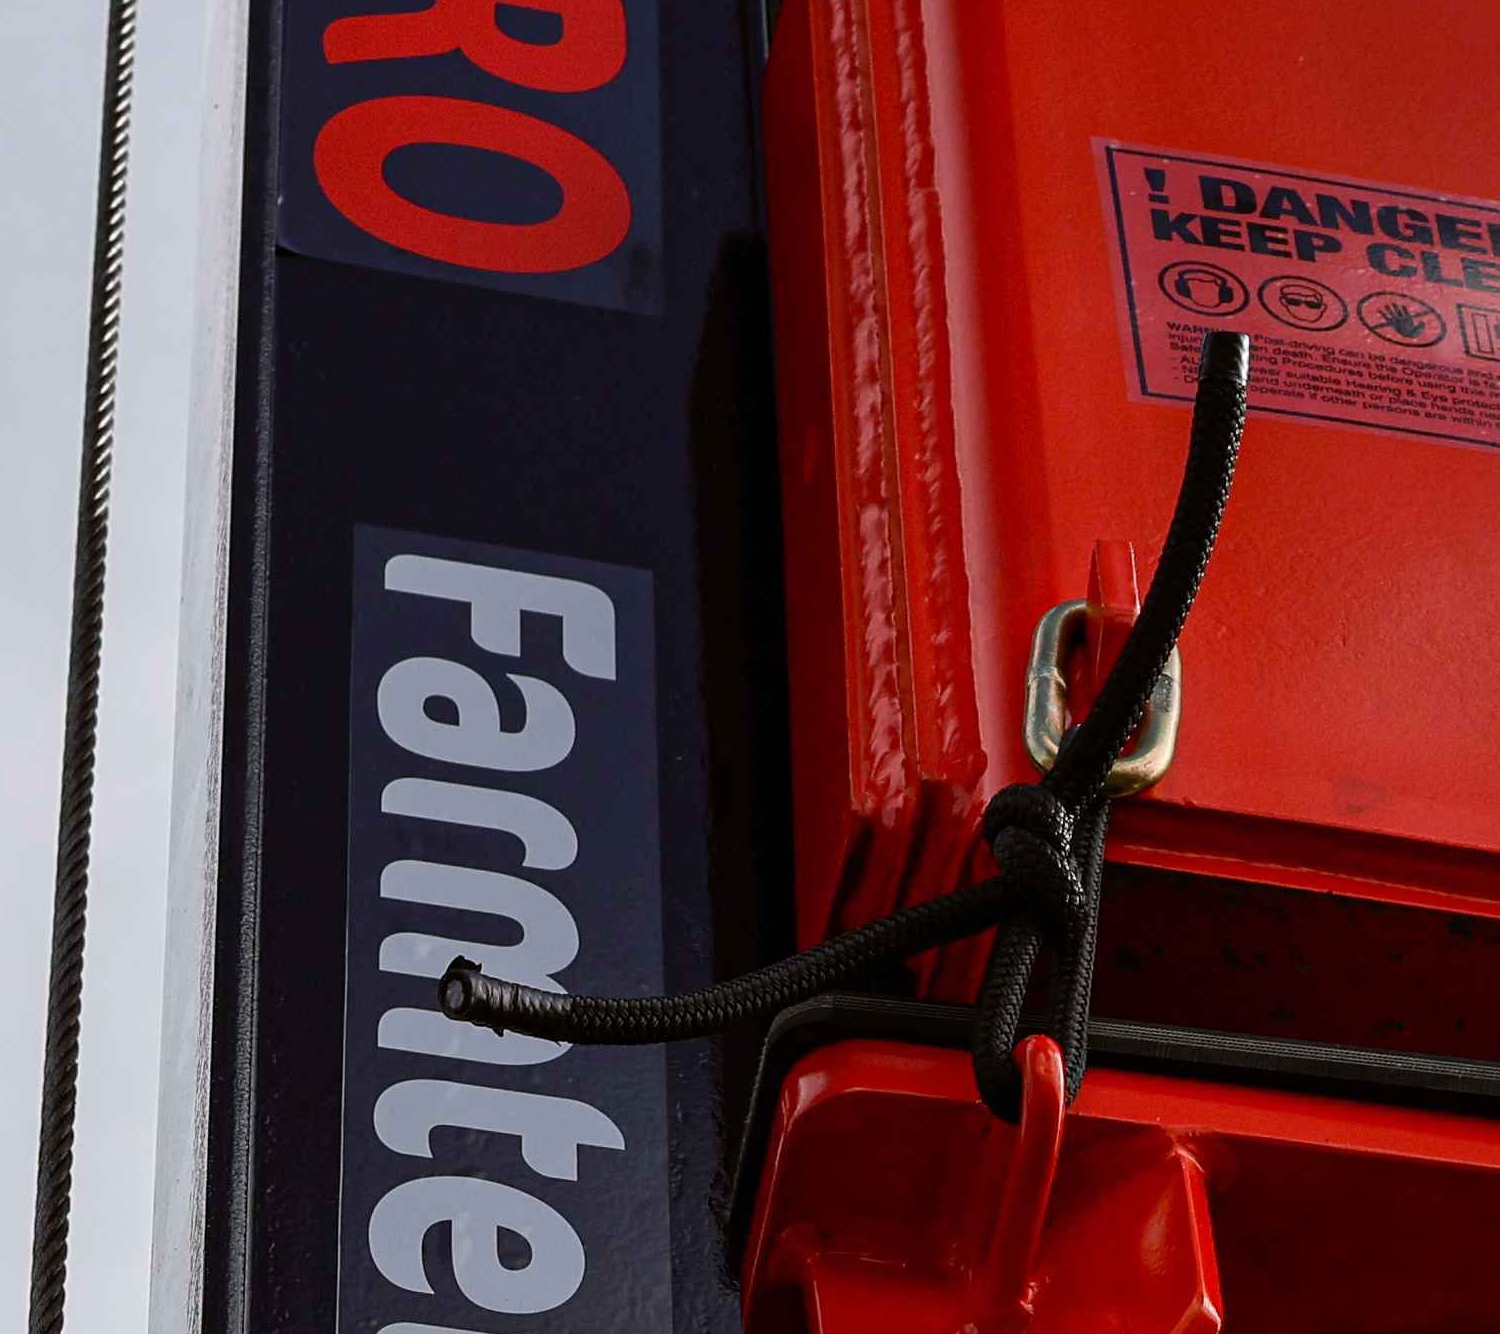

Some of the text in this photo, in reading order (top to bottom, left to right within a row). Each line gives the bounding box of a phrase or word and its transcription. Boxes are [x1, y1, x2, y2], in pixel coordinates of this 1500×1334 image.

[1151, 208, 1343, 263] KEEP
[1282, 357, 1364, 378] Procedures
[1368, 371, 1413, 385] before
[1417, 380, 1456, 393] using
[1459, 386, 1484, 396] this
[1321, 354, 1371, 369] Ensure
[1375, 363, 1397, 373] the
[1401, 367, 1463, 384] Operator
[1389, 355, 1463, 375] dangerous
[1282, 378, 1365, 398] underneath
[1387, 395, 1427, 409] place
[1430, 401, 1475, 415] hands
[1284, 369, 1341, 385] suitable
[1345, 379, 1401, 396] Hearing
[1419, 390, 1448, 403] Eye
[1248, 383, 1305, 400] operate
[1320, 393, 1357, 407] other
[1361, 400, 1421, 418] persons
[1423, 411, 1446, 420] are
[1450, 414, 1491, 428] within
